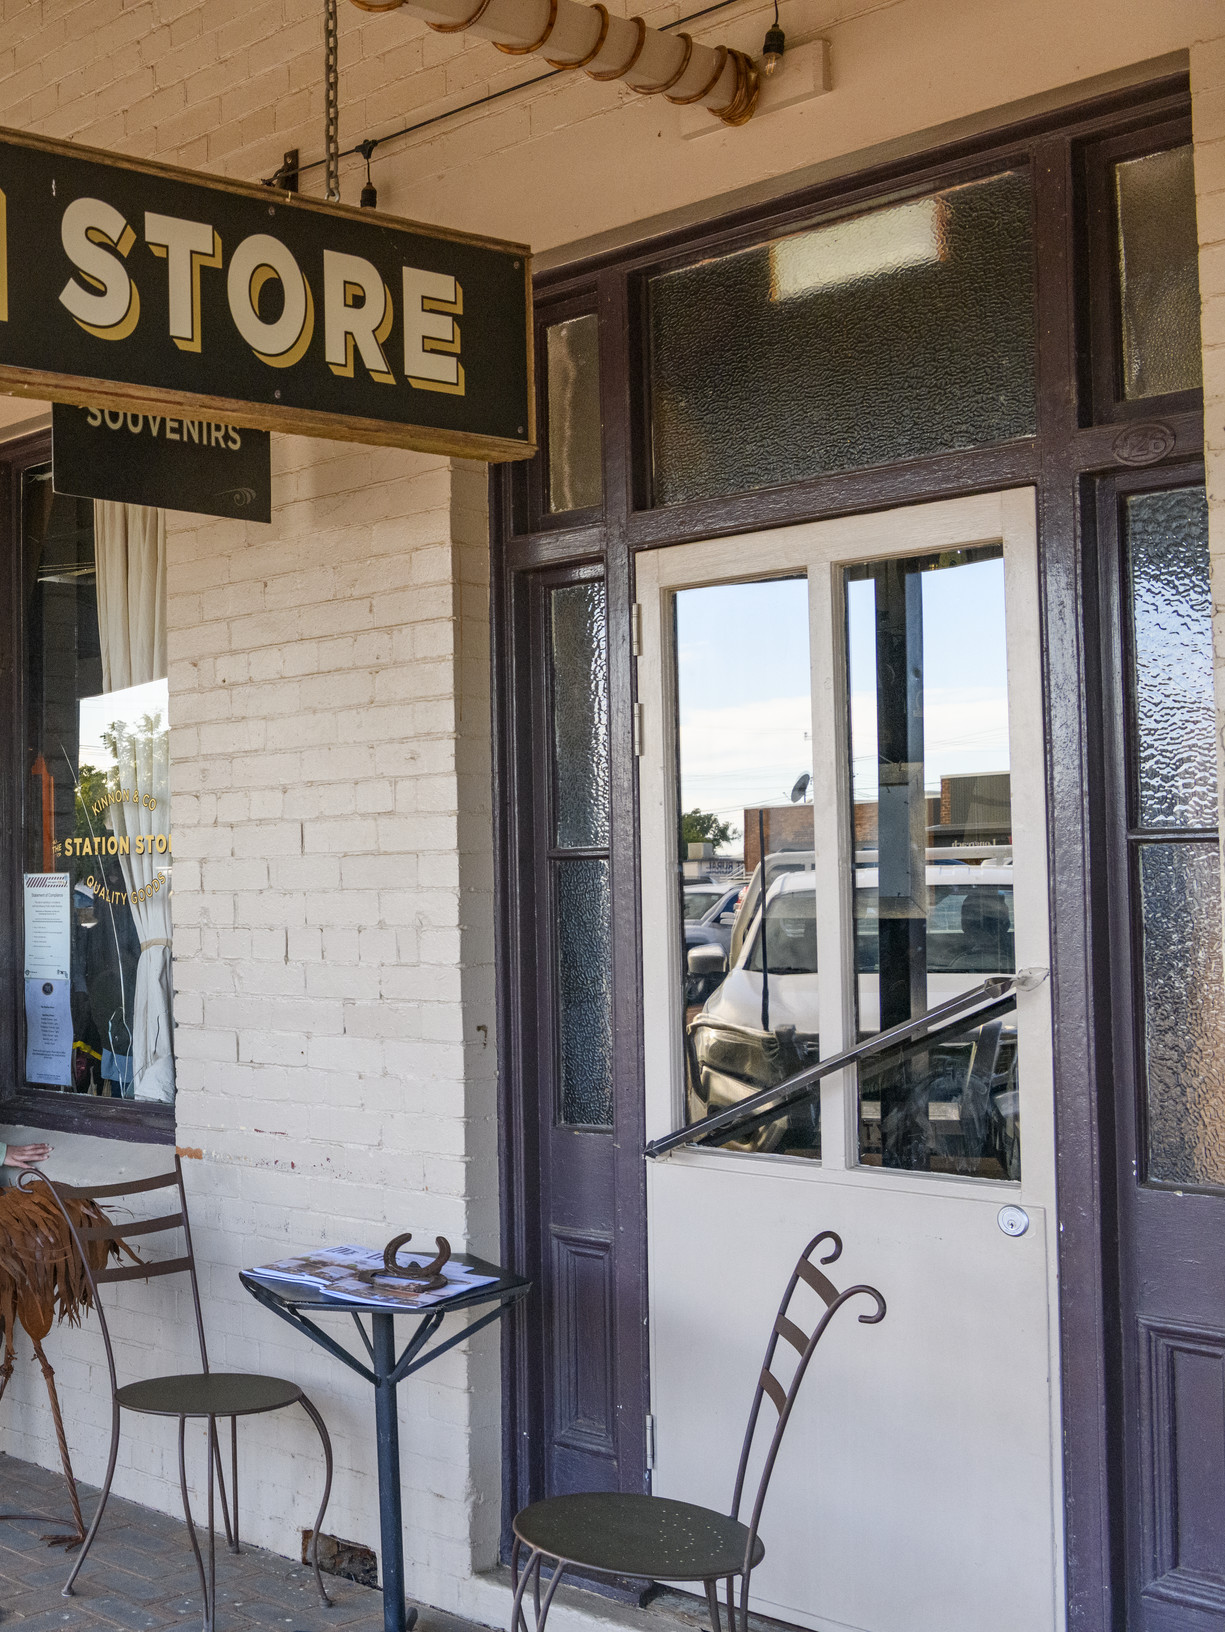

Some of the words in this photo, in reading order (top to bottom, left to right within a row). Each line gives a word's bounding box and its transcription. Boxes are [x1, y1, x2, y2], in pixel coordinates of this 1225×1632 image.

[59, 197, 466, 397] STORE
[87, 407, 241, 450] SOUVENIRS
[91, 788, 130, 816] KINNON
[132, 790, 139, 804] &
[142, 794, 157, 812] CO
[52, 843, 63, 853] THE
[65, 836, 130, 856] STATION
[86, 875, 127, 905] QUALITY
[130, 871, 166, 904] GOODS
